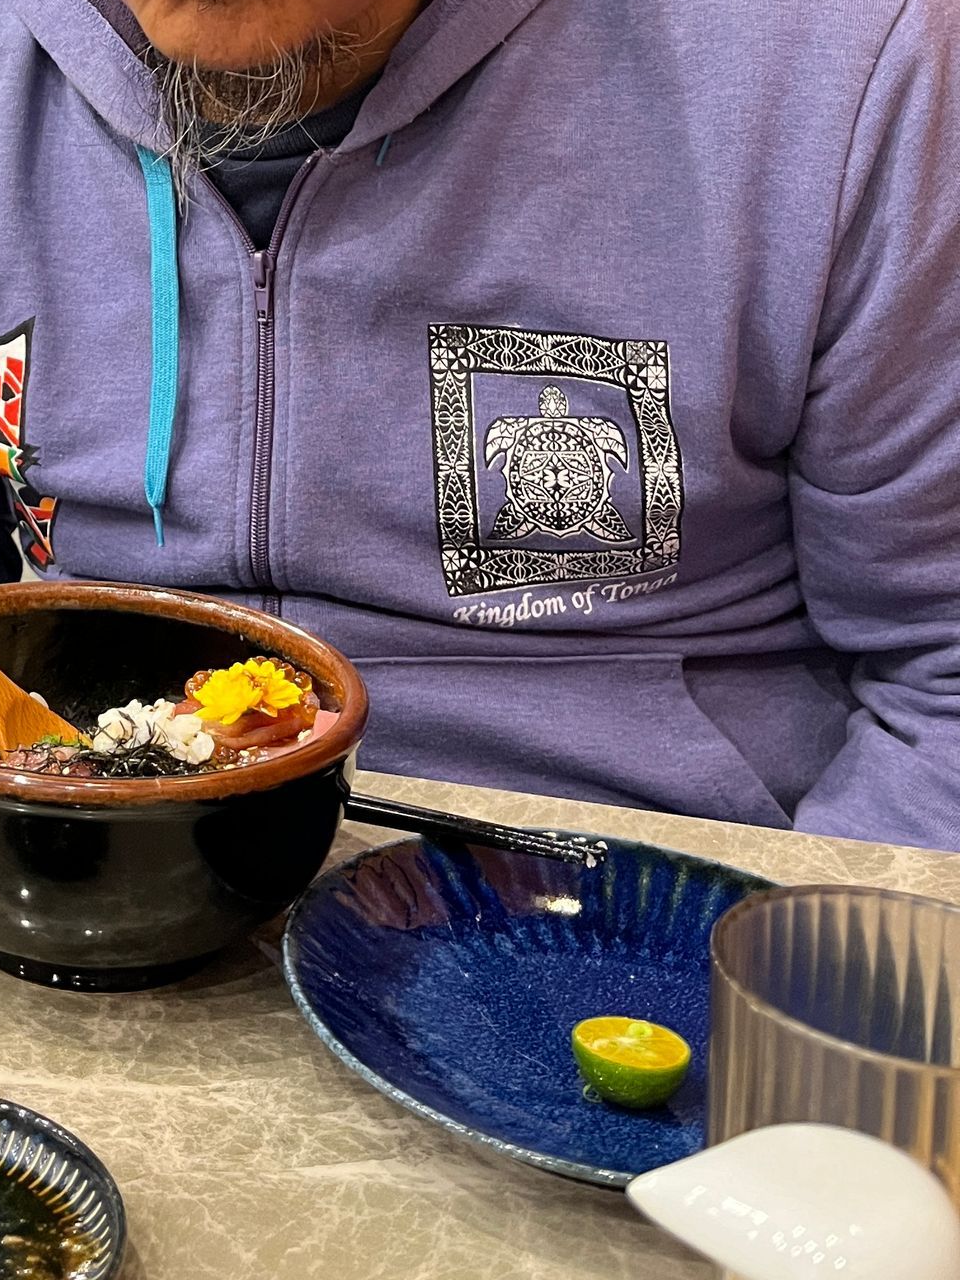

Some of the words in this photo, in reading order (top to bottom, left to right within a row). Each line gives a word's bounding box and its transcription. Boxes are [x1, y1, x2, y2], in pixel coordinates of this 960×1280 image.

[453, 592, 566, 627] Kingdom
[571, 583, 601, 614] of
[601, 572, 678, 604] Tonga
